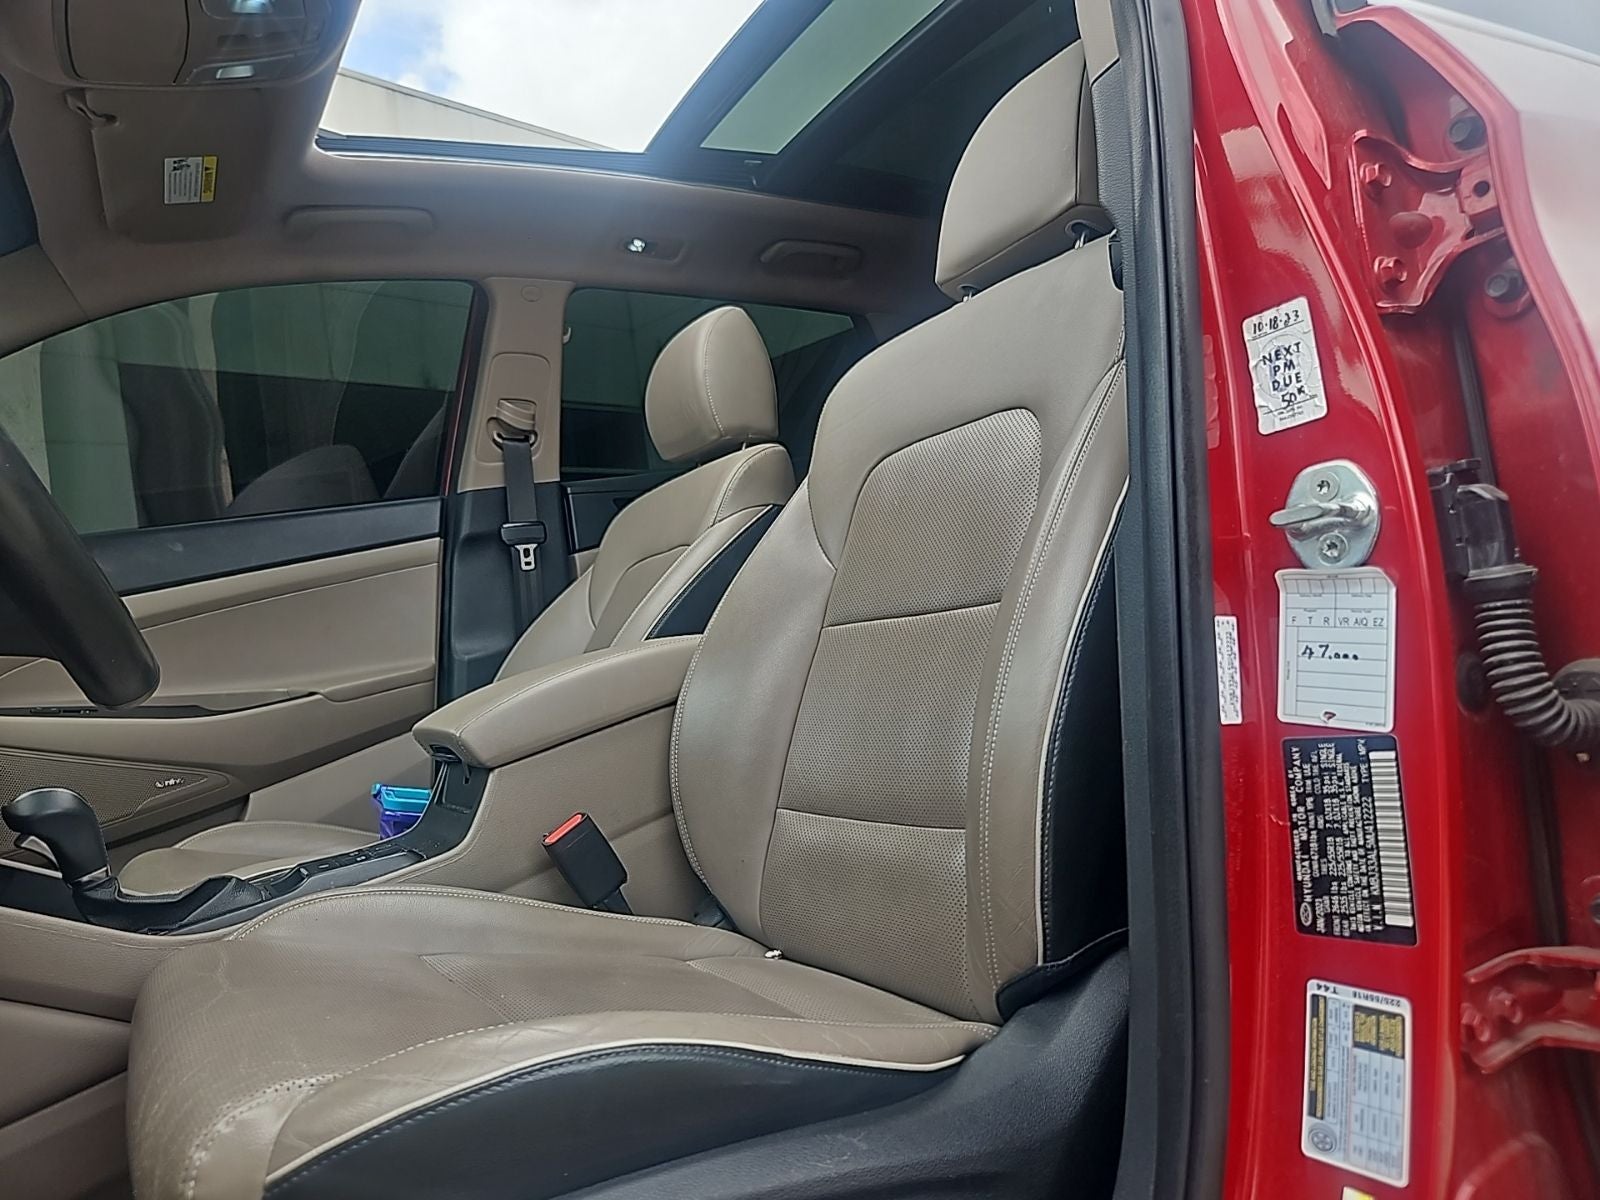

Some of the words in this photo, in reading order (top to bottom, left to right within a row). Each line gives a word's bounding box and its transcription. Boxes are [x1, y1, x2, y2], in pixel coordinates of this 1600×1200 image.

[1262, 342, 1301, 365] NEXT
[1273, 360, 1296, 377] PM
[1272, 372, 1302, 392] DUE
[1292, 616, 1296, 624] F
[1308, 616, 1313, 624] T
[1324, 618, 1330, 626] R
[1373, 618, 1384, 627] EZ
[1291, 746, 1304, 793] COMPANY
[1360, 763, 1369, 784] TYPE
[1312, 778, 1320, 794] COLD
[1296, 806, 1308, 841] MOTOR
[1300, 854, 1313, 903] HYUNDAI
[1316, 983, 1338, 995] T44
